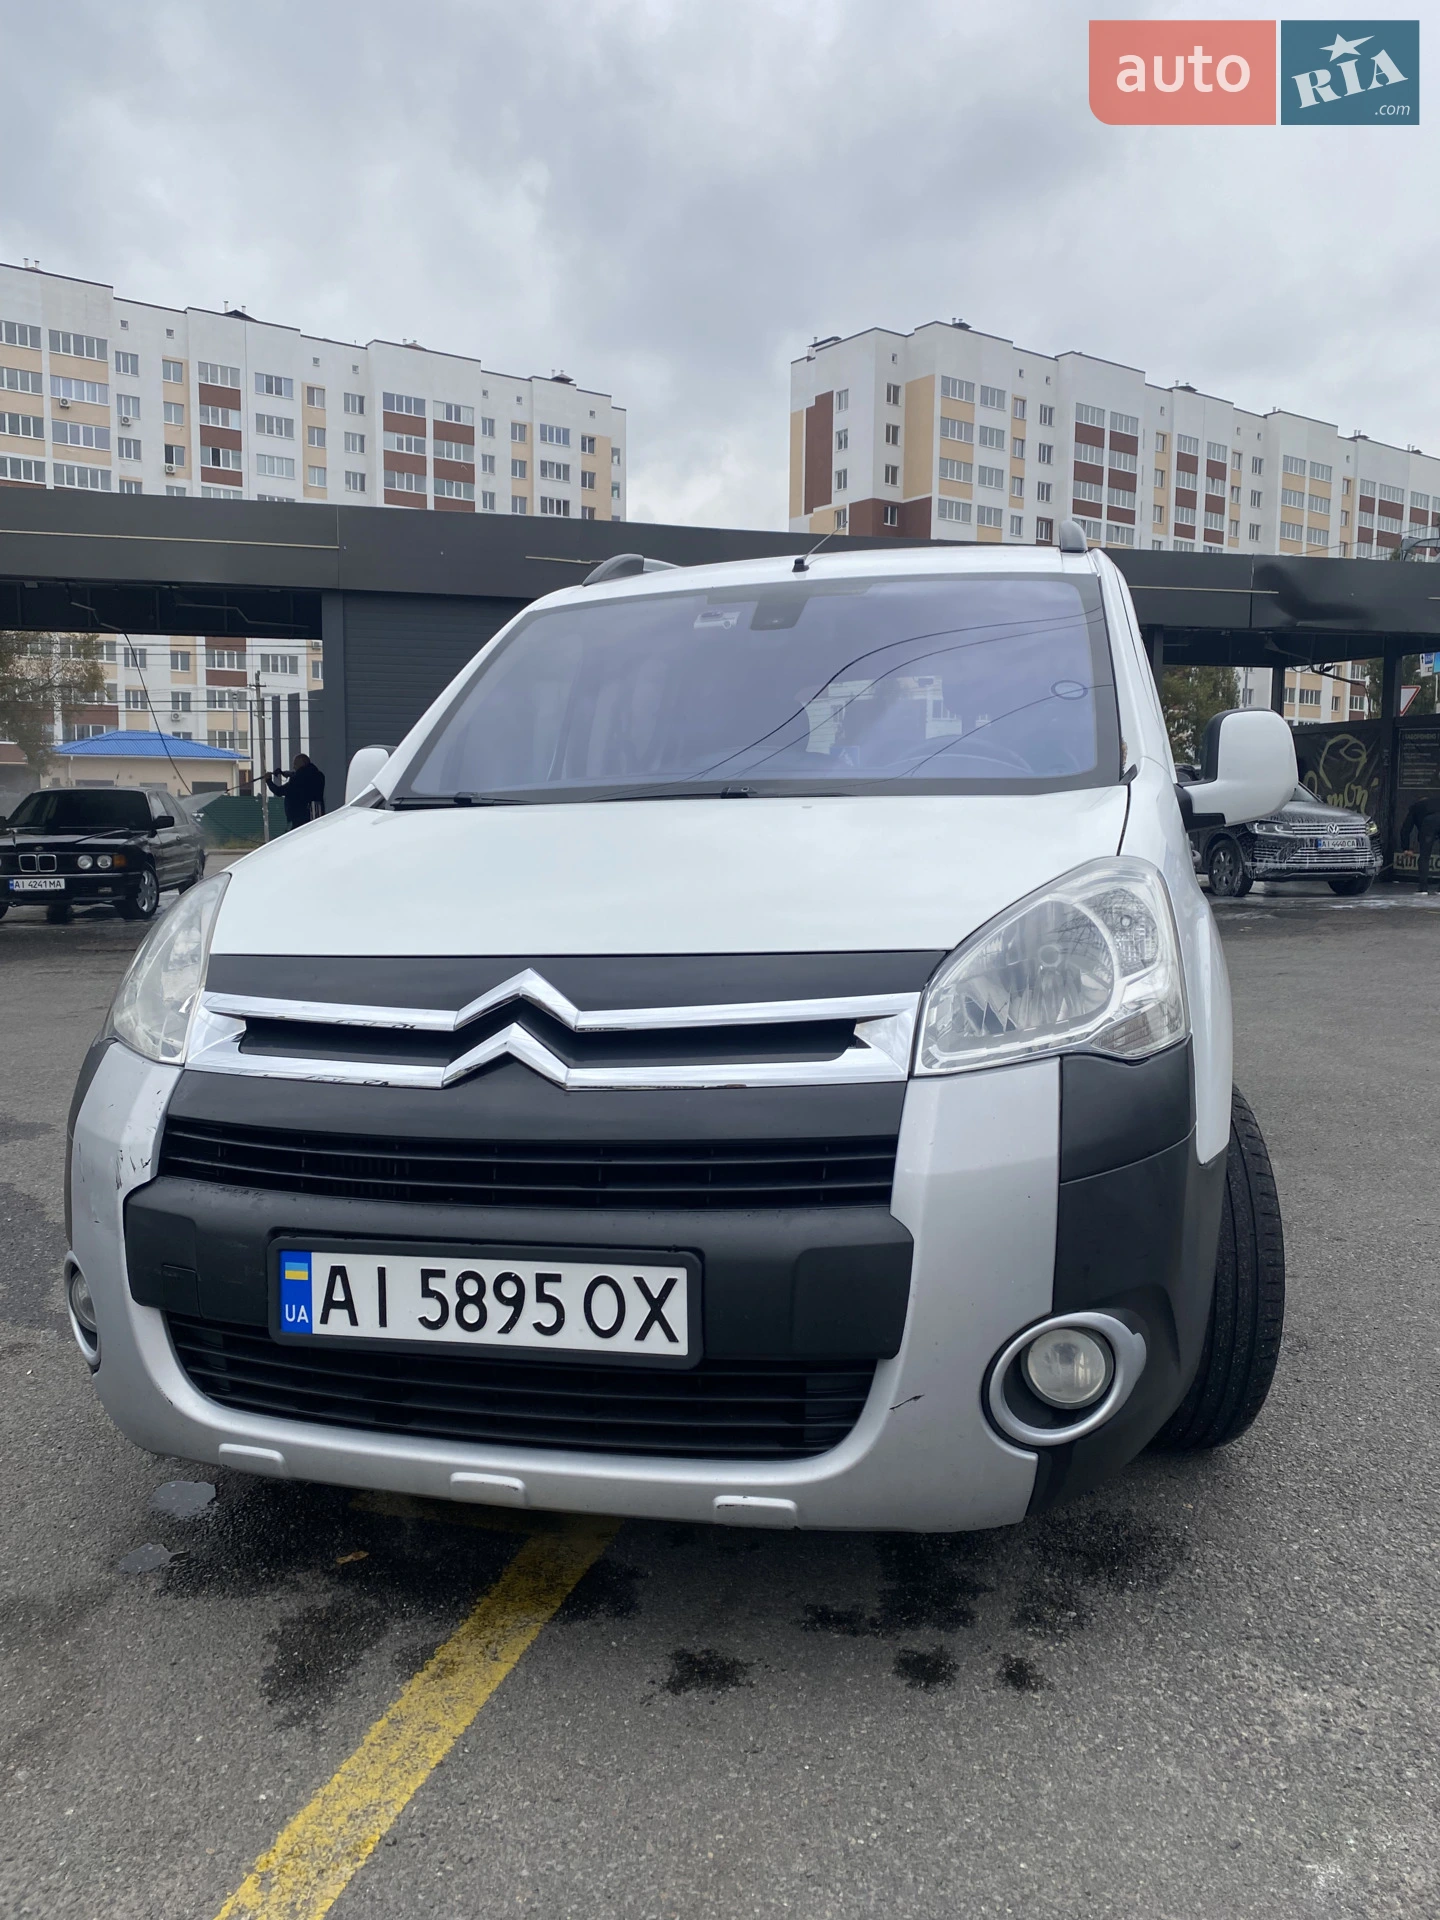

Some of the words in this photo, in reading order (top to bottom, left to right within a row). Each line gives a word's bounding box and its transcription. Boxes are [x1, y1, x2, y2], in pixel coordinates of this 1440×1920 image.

[49, 880, 62, 888] MA
[285, 1304, 309, 1324] UA
[319, 1265, 387, 1328] AI
[417, 1268, 565, 1336] 5895
[583, 1274, 680, 1343] OX
